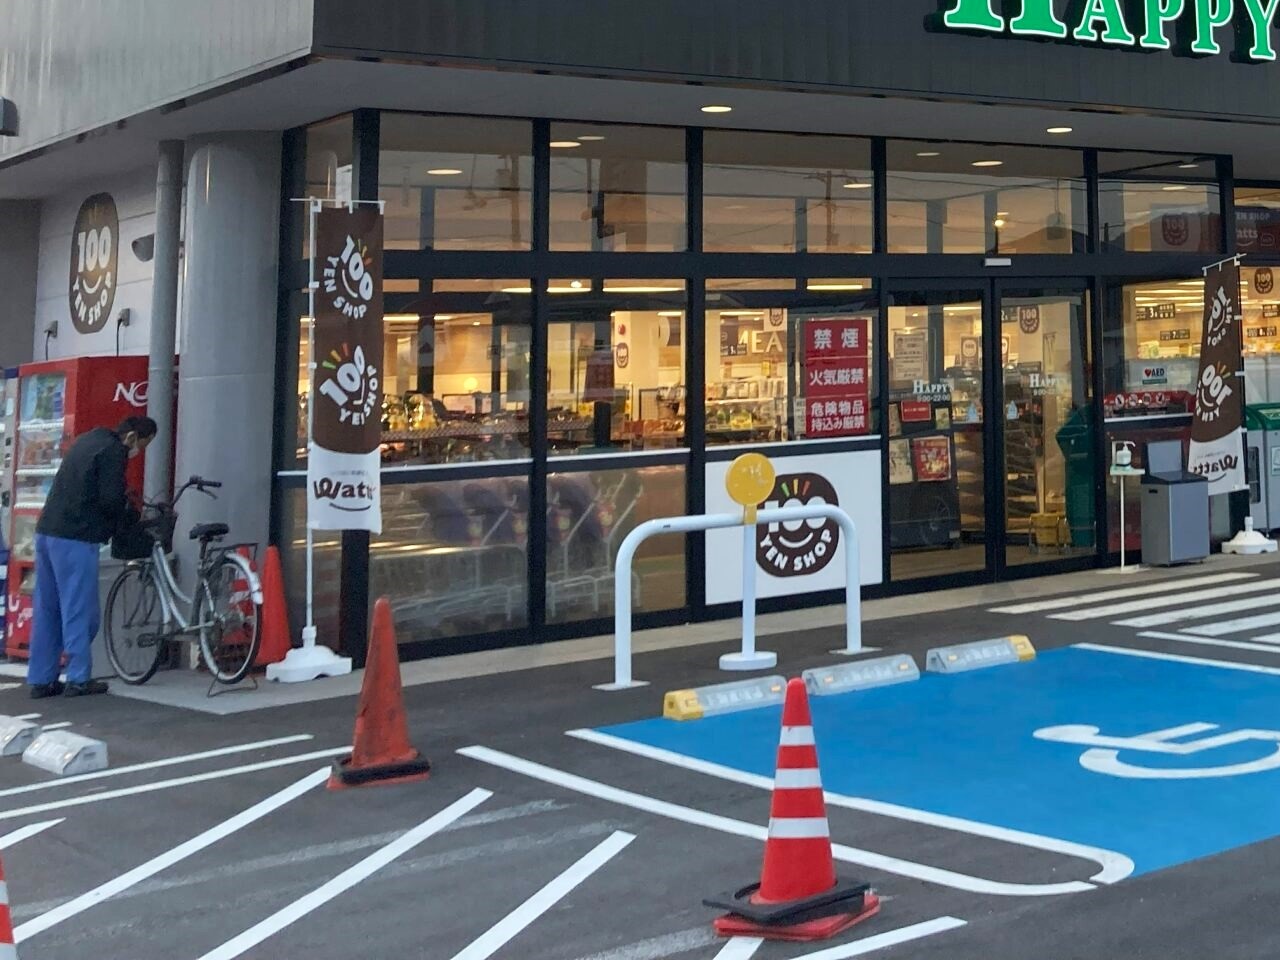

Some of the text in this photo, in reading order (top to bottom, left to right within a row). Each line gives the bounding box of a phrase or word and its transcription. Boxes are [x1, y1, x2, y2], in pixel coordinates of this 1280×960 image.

[1236, 228, 1259, 239] atts
[78, 226, 112, 272] 100
[341, 234, 373, 301] 100
[323, 256, 367, 320] YEN SHOP
[1022, 308, 1037, 320] 100
[813, 327, 860, 350] 禁煙
[319, 345, 365, 406] 100
[809, 368, 865, 387] 火気厳禁
[1151, 367, 1165, 377] AED
[810, 400, 865, 418] 危険物品
[760, 528, 833, 571] YEN SHOP
